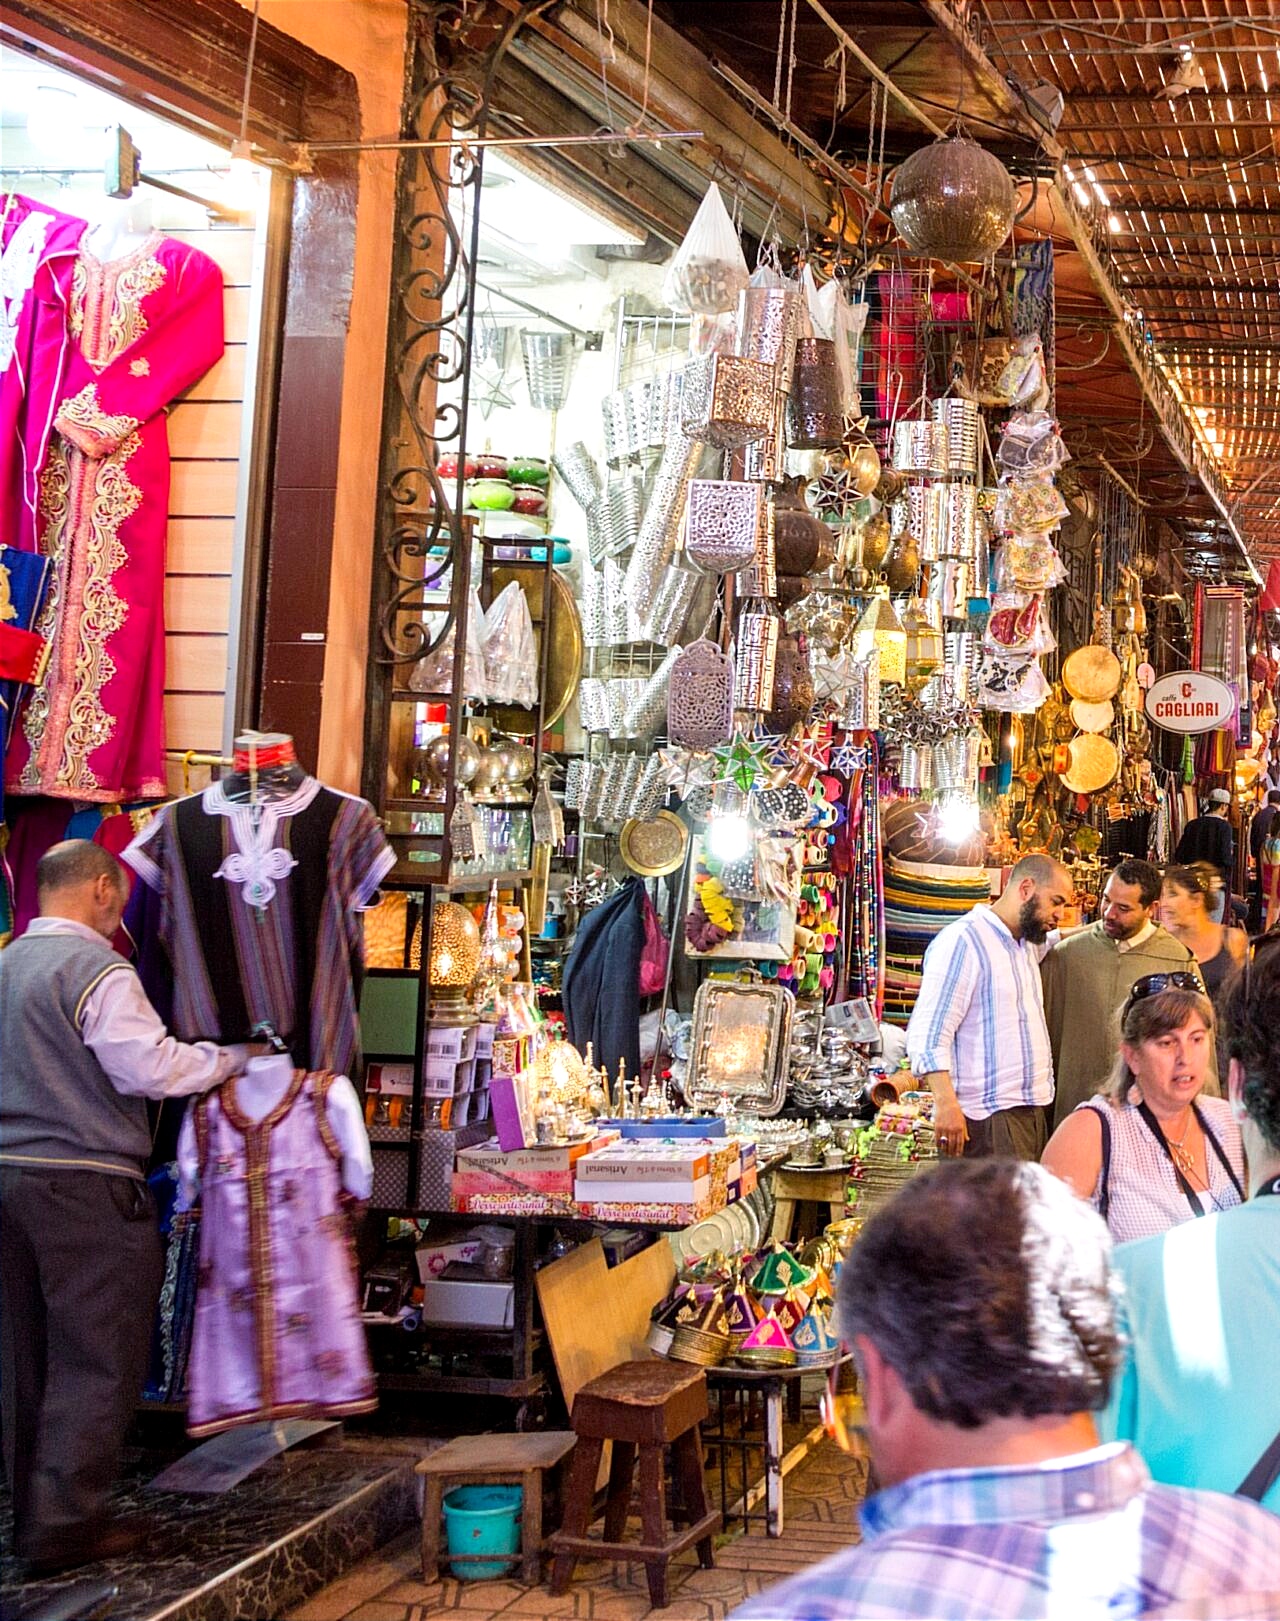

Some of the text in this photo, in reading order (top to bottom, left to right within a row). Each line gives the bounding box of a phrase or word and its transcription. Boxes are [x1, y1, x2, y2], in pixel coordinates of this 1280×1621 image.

[1155, 702, 1219, 717] CAGLIARI
[585, 1165, 628, 1175] Artisanal
[622, 1208, 670, 1219] artisanal
